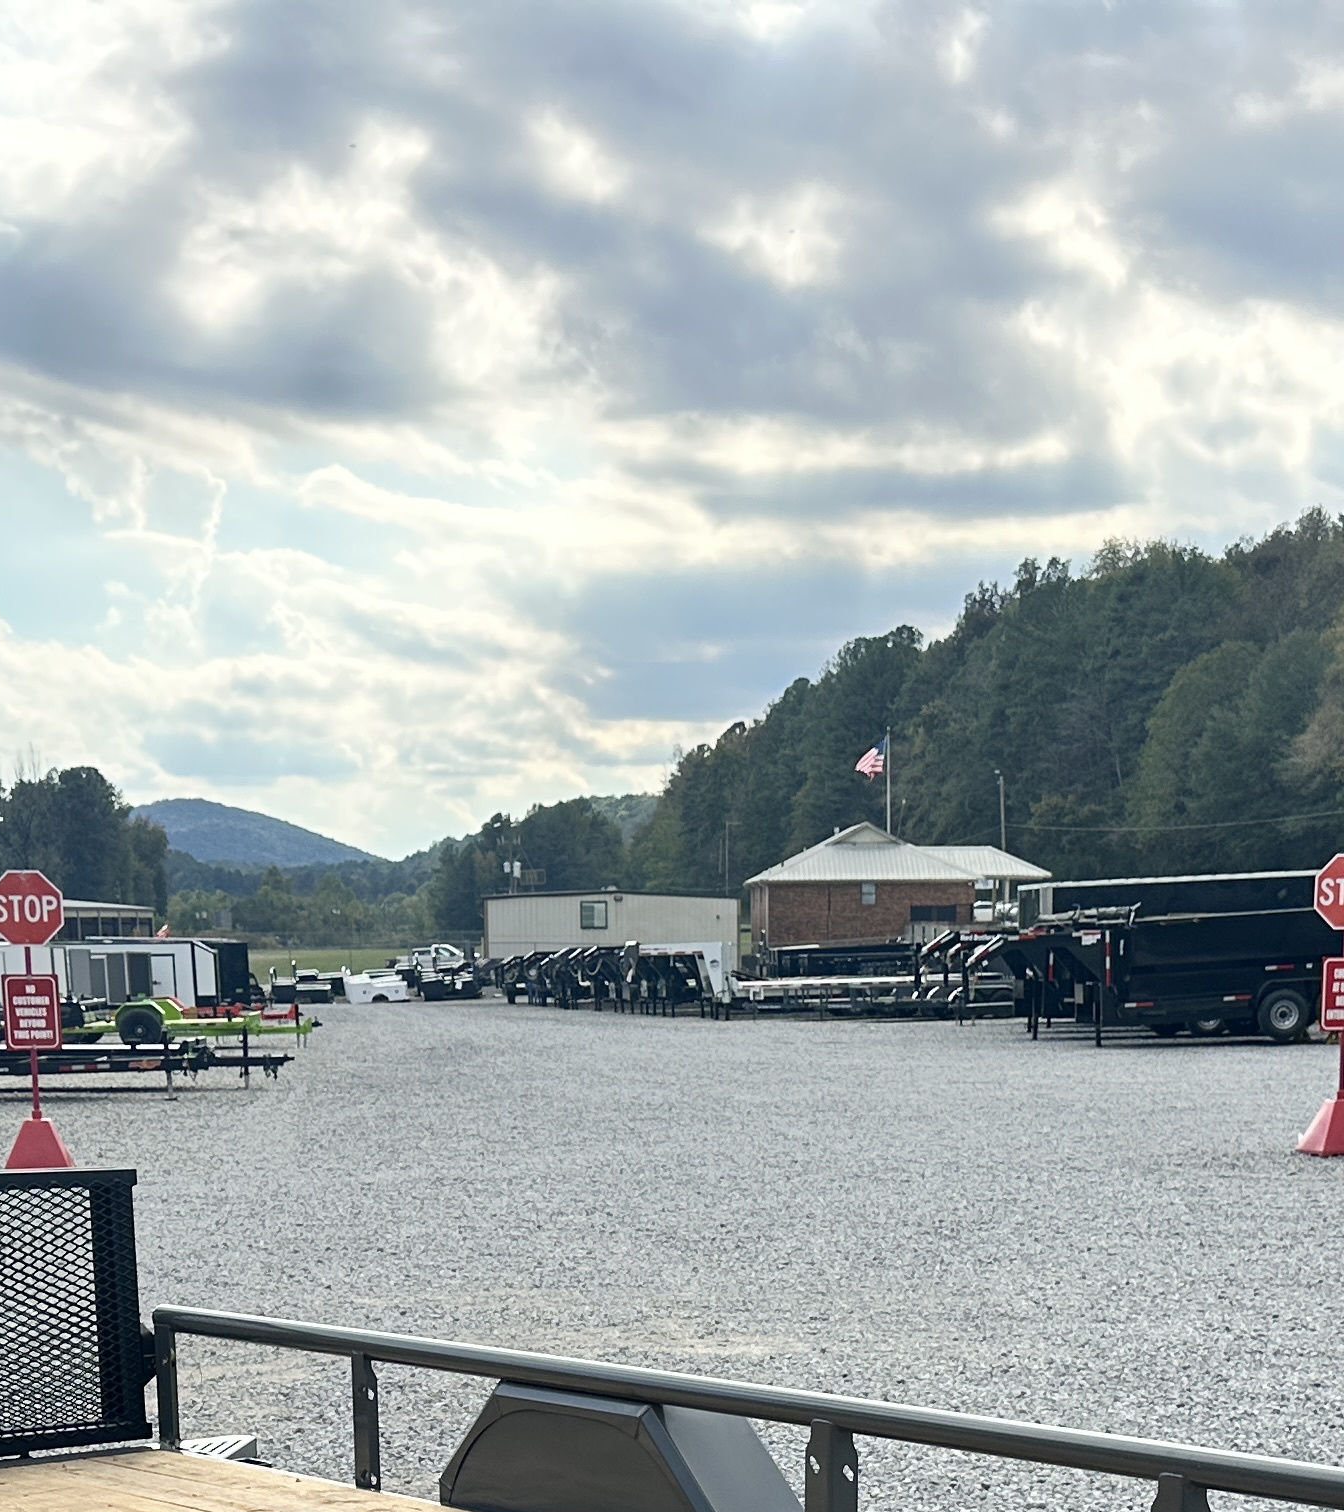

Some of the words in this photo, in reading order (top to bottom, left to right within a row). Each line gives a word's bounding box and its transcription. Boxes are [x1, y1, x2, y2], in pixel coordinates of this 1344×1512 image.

[25, 984, 36, 994] NO
[1331, 982, 1340, 993] AT
[12, 995, 50, 1006] CUSTOMER
[15, 1007, 48, 1017] VEHICLES
[19, 1018, 47, 1028] BEYOND
[13, 1030, 30, 1040] THIS
